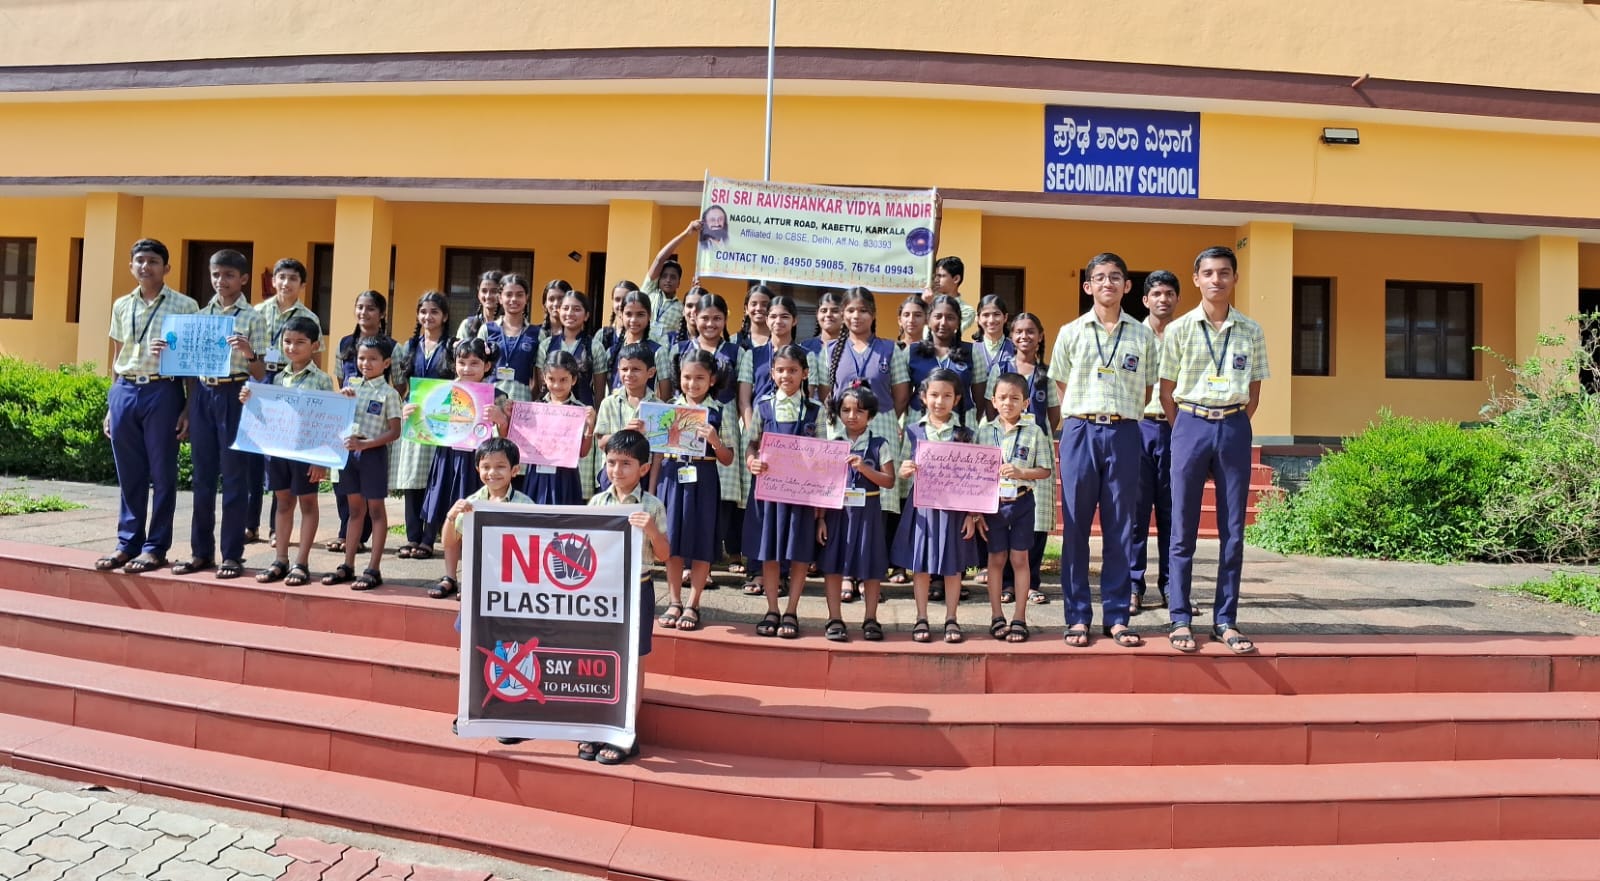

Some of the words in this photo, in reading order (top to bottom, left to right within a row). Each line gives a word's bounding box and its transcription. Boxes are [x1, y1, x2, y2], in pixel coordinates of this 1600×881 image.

[1053, 117, 1091, 156] ಪ್ರೌಢ
[1096, 126, 1139, 151] ಶಾಲಾ
[1145, 124, 1192, 158] ವಿಭಾಗ
[1046, 162, 1134, 193] SECONDARY
[1138, 166, 1196, 195] SCHOOL
[712, 188, 730, 204] SRI
[734, 190, 752, 206] SRI
[756, 193, 843, 214] RAVISHANKAR
[846, 200, 881, 216] VIDYA
[885, 202, 932, 218] MANDIR
[730, 214, 762, 224] NAGOLI,
[764, 218, 791, 226] ATTUR
[794, 220, 818, 230] ROAD,
[822, 223, 862, 234] KABETTU,
[865, 226, 906, 235] KARKALA
[740, 228, 772, 240] Affiliated
[784, 232, 810, 243] CBSE,
[812, 234, 834, 246] Delhi,
[863, 239, 892, 248] 830393
[716, 250, 757, 262] CONTACT
[783, 257, 812, 268] 84950
[815, 260, 846, 271] 59085,
[852, 262, 880, 273] 76764
[885, 265, 914, 275] 09943
[487, 591, 618, 618] PLASTICS!
[546, 659, 572, 675] SAY
[578, 659, 606, 676] NO
[544, 682, 558, 692] TO
[561, 683, 611, 694] PLASTICS!
